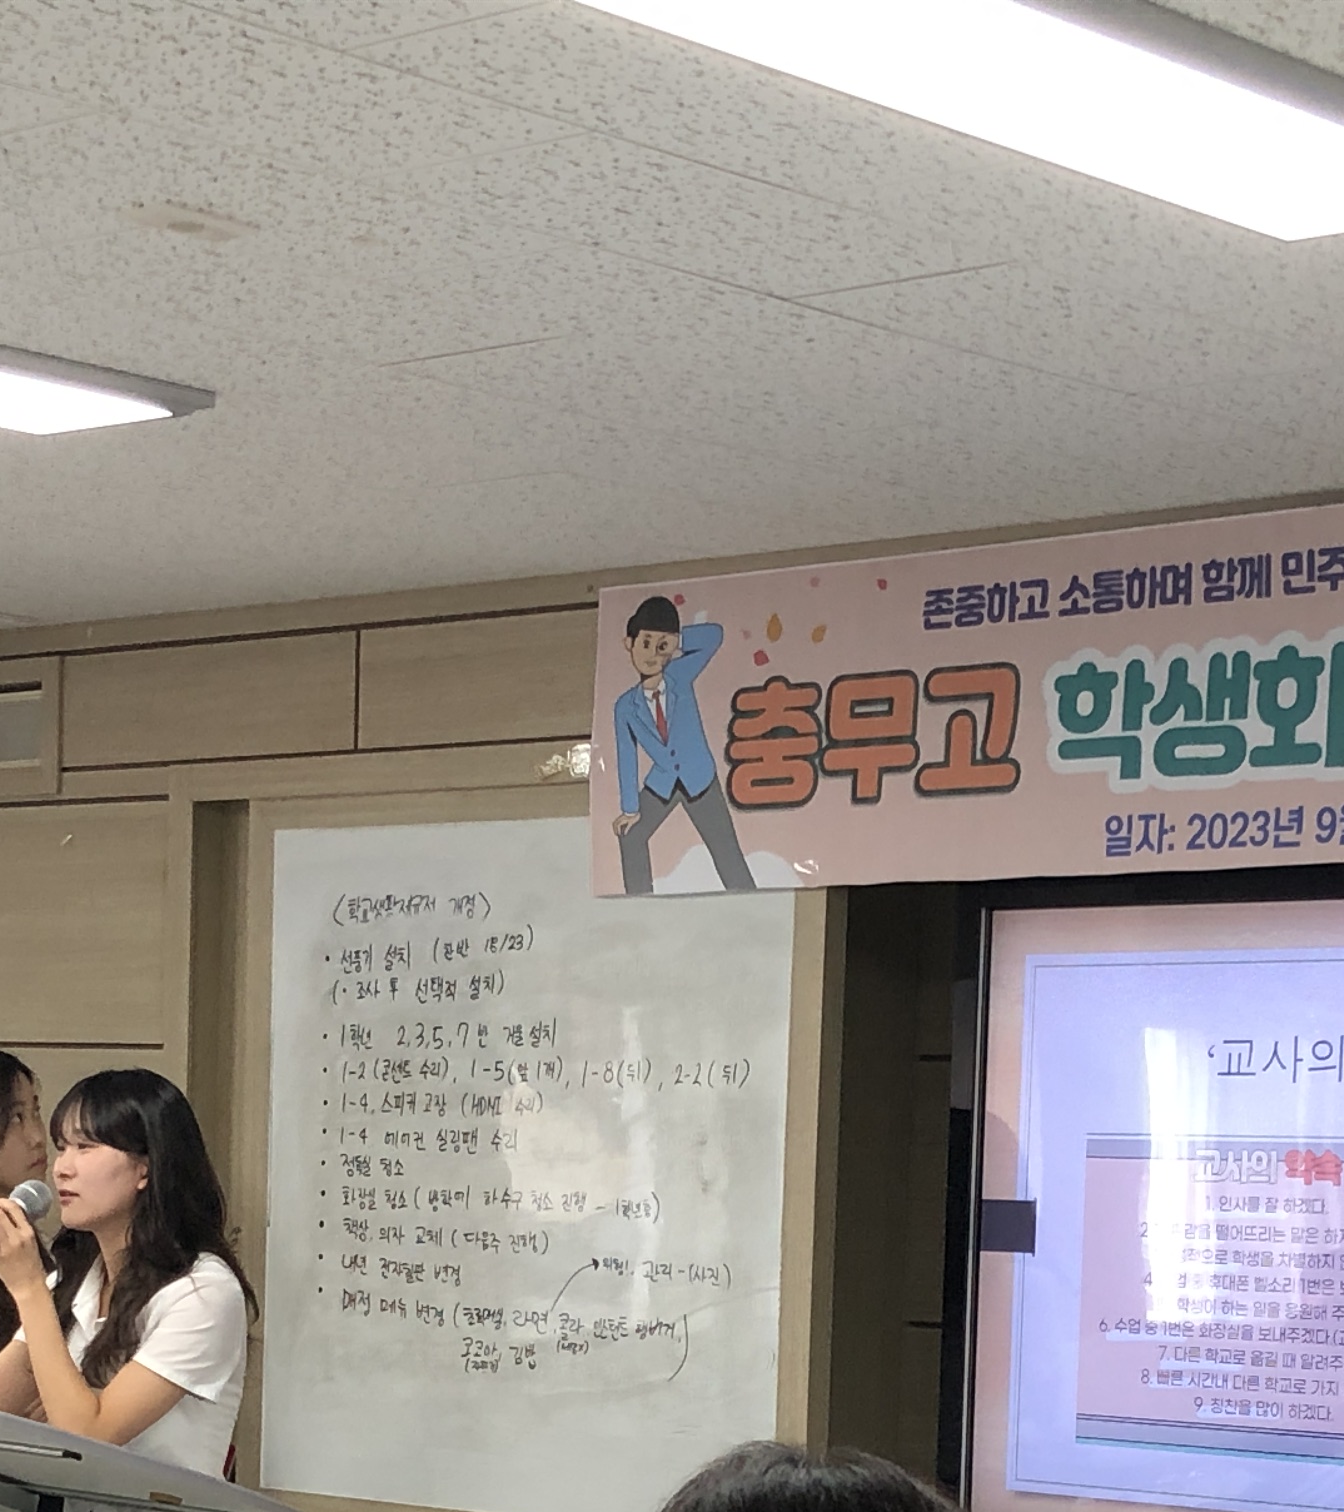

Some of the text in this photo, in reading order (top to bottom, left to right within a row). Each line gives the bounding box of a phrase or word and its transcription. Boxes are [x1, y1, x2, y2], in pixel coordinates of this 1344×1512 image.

[922, 577, 1050, 630] 존중하고
[1057, 562, 1193, 618] 소통하며
[1200, 552, 1273, 602] 함께
[726, 660, 1022, 810] 충무고
[1104, 812, 1176, 858] 일자:
[1186, 804, 1305, 850] 2023년
[341, 943, 372, 974] 선풍기
[384, 940, 411, 972] 설치
[529, 1019, 556, 1049] 설치
[380, 1091, 417, 1117] 스피커
[423, 1093, 446, 1117] 고장
[1192, 1148, 1343, 1187] 교사의 약속
[342, 1186, 377, 1211] 화장실
[1219, 1195, 1260, 1214] 인사를
[1264, 1196, 1278, 1214] 잘
[378, 1225, 405, 1245] 의자
[415, 1226, 443, 1247] 교체
[1215, 1222, 1286, 1243] 떨어뜨리는
[1232, 1250, 1273, 1268] 학생을
[1278, 1252, 1335, 1270] 차별하지
[433, 1263, 461, 1287] 변경
[1299, 1277, 1335, 1296] 1번은
[380, 1296, 406, 1319] 메뉴
[416, 1299, 445, 1327] 변경
[1221, 1299, 1249, 1317] 하는
[1285, 1302, 1327, 1321] 응원해
[1114, 1317, 1142, 1335] 수업
[1162, 1320, 1195, 1338] 1번은
[1198, 1322, 1254, 1342] 화장실을
[1174, 1346, 1201, 1364] 다른
[1205, 1347, 1246, 1365] 학교로
[1282, 1352, 1296, 1369] 때
[1187, 1371, 1229, 1390] 시간내
[1233, 1373, 1260, 1392] 다른
[1264, 1376, 1306, 1395] 학교로
[1310, 1379, 1339, 1397] 가지
[1210, 1397, 1251, 1416] 칭찬을
[1255, 1400, 1284, 1419] 많이
